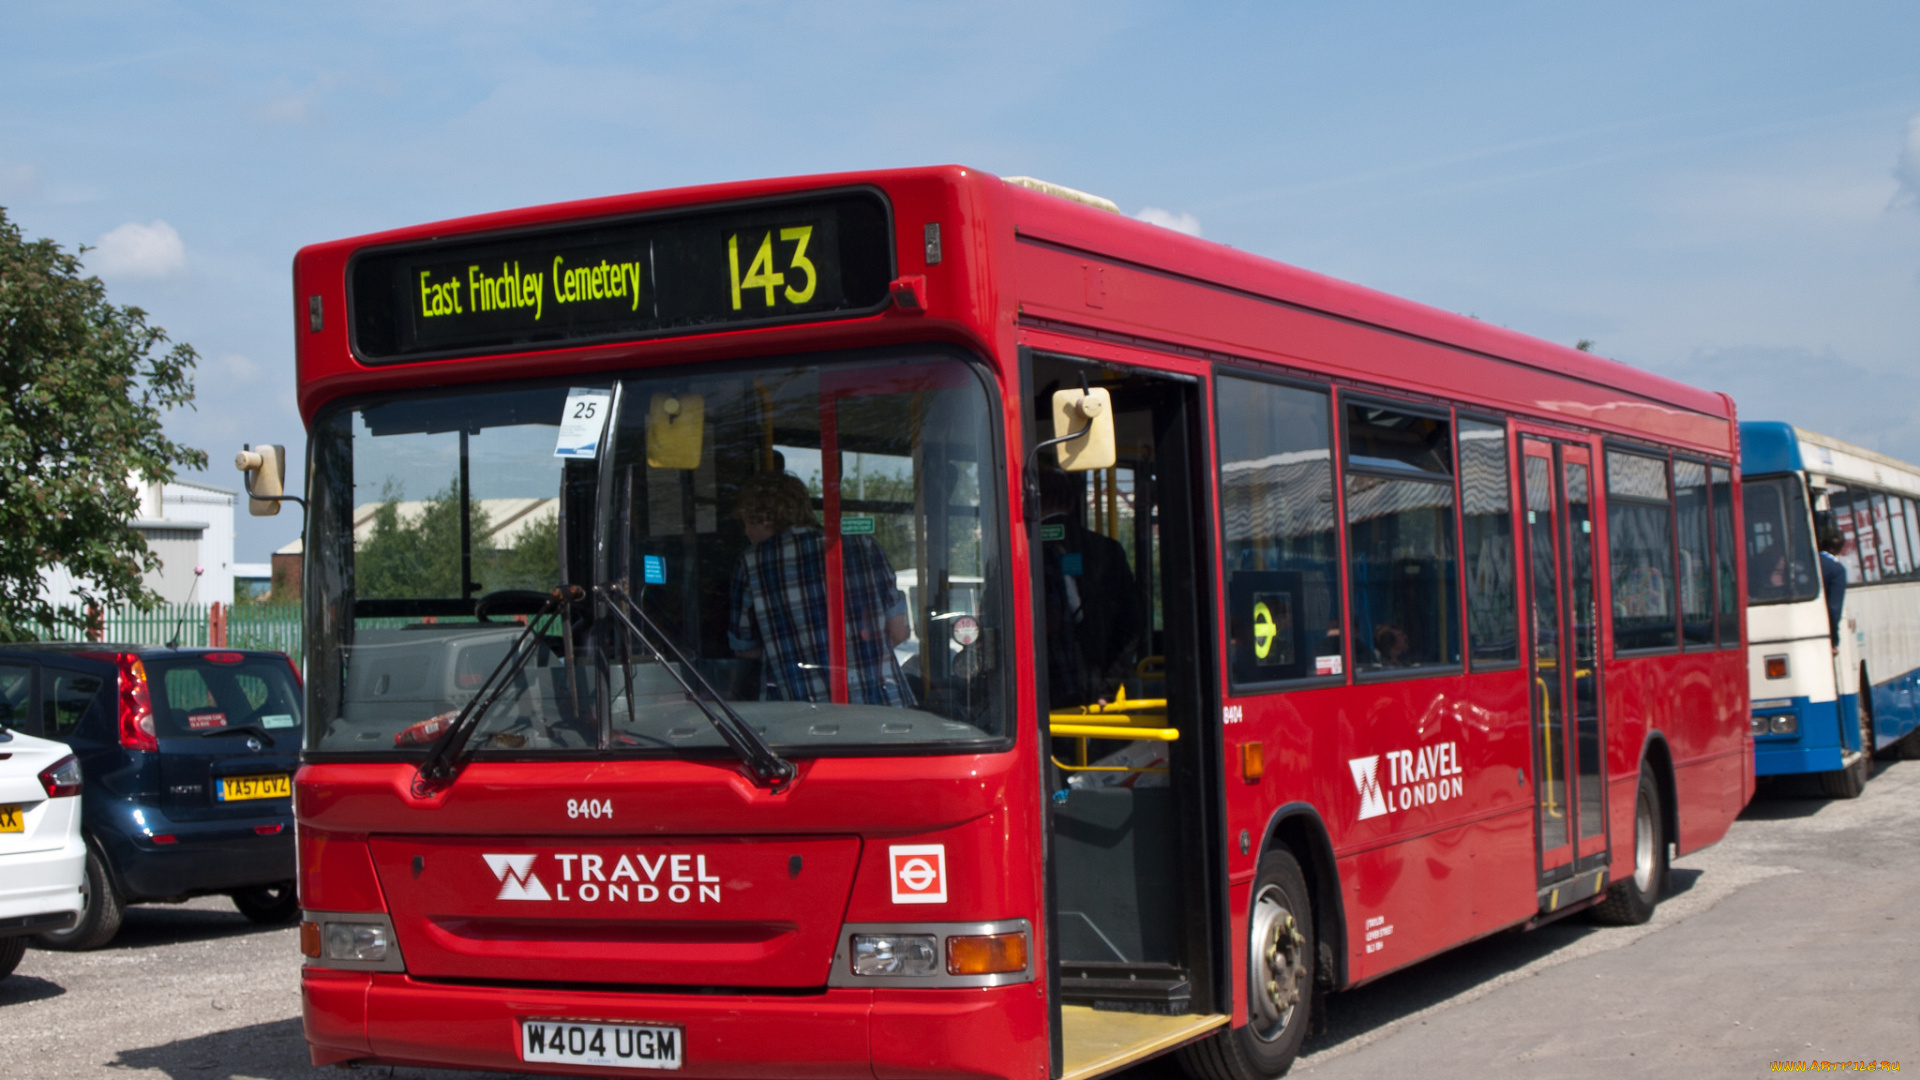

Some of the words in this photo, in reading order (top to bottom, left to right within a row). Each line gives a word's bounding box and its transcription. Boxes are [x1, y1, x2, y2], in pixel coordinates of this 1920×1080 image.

[726, 225, 818, 311] 143
[420, 271, 463, 317] East
[468, 260, 544, 321] Finchley
[552, 255, 640, 312] Cemetery
[573, 402, 597, 419] 25
[1223, 705, 1243, 724] 8404
[1386, 741, 1463, 787] TRAVEL
[225, 779, 259, 796] YA57
[1388, 776, 1463, 813] LONDON
[566, 799, 613, 819] 8404
[554, 854, 720, 882] TRAVEL
[557, 884, 721, 903] LONDON
[528, 1024, 606, 1057] W404
[615, 1028, 675, 1061] UGM
